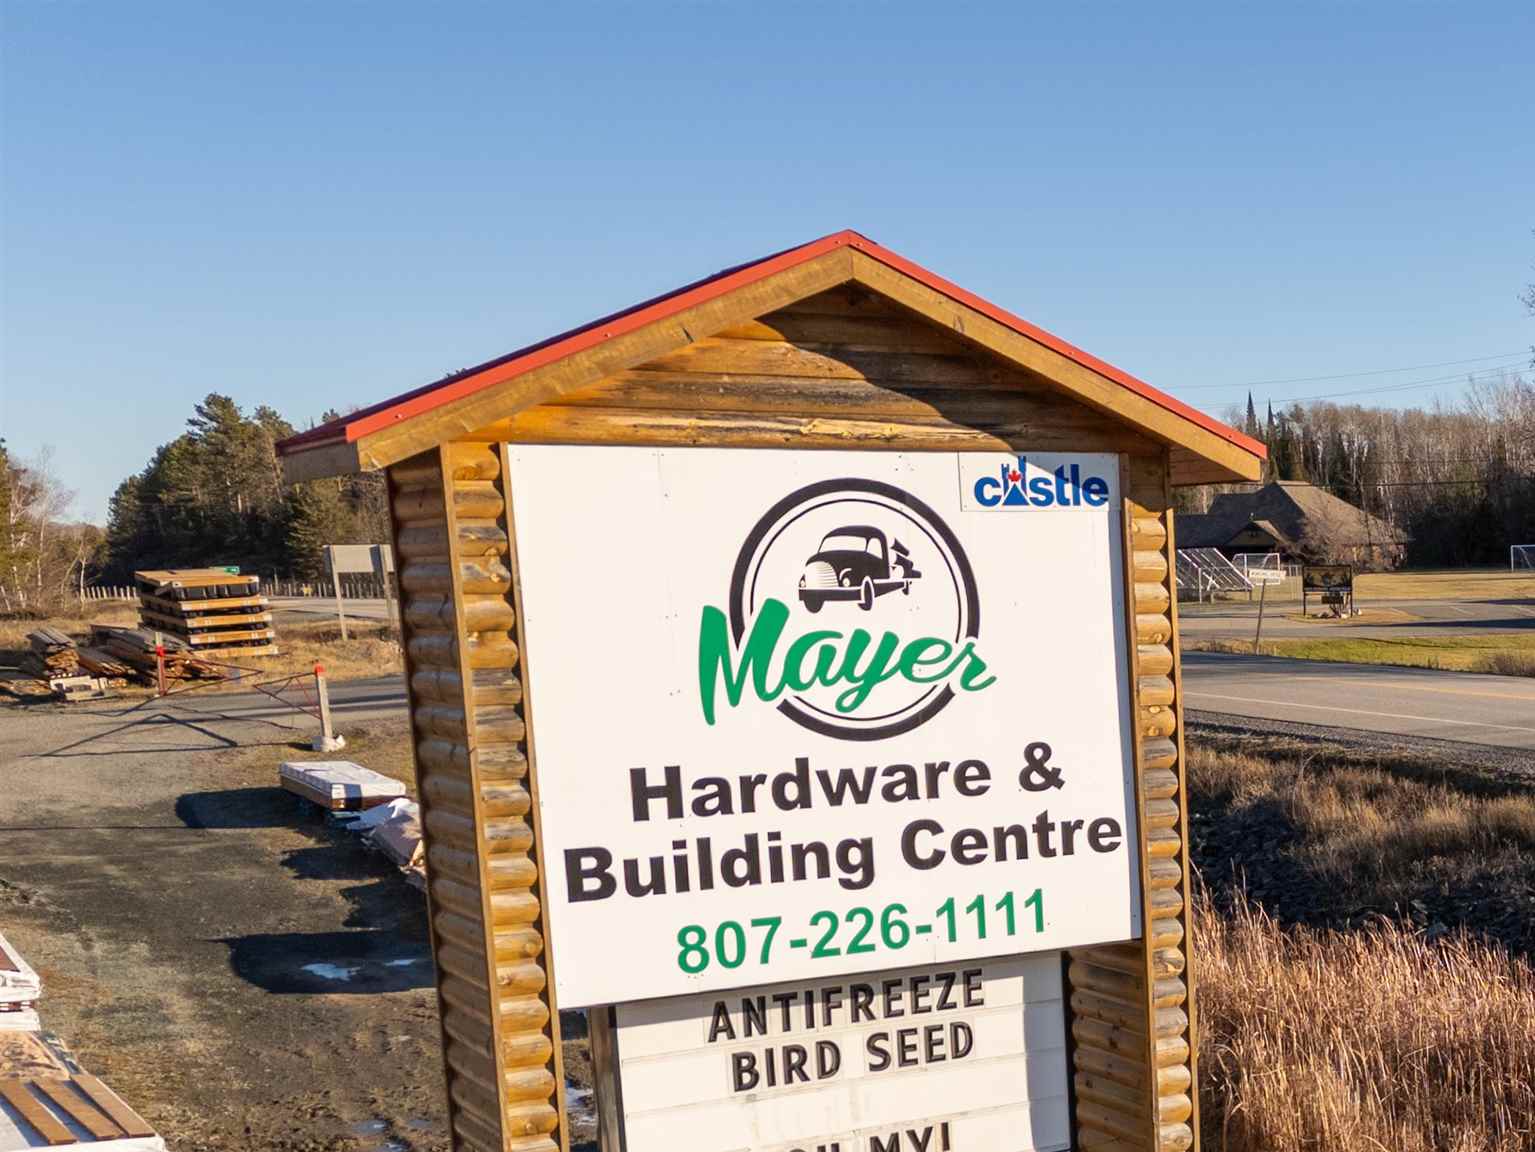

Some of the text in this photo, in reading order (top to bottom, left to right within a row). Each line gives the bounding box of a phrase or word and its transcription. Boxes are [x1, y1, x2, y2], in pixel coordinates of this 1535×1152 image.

[699, 597, 997, 726] Mayer
[629, 741, 1066, 822] Hardware &
[563, 810, 1123, 903] Building Centre
[676, 888, 1046, 975] 807-226-1111
[707, 968, 986, 1043] ANTIFREEZE
[731, 1021, 974, 1093] BIRD SEED
